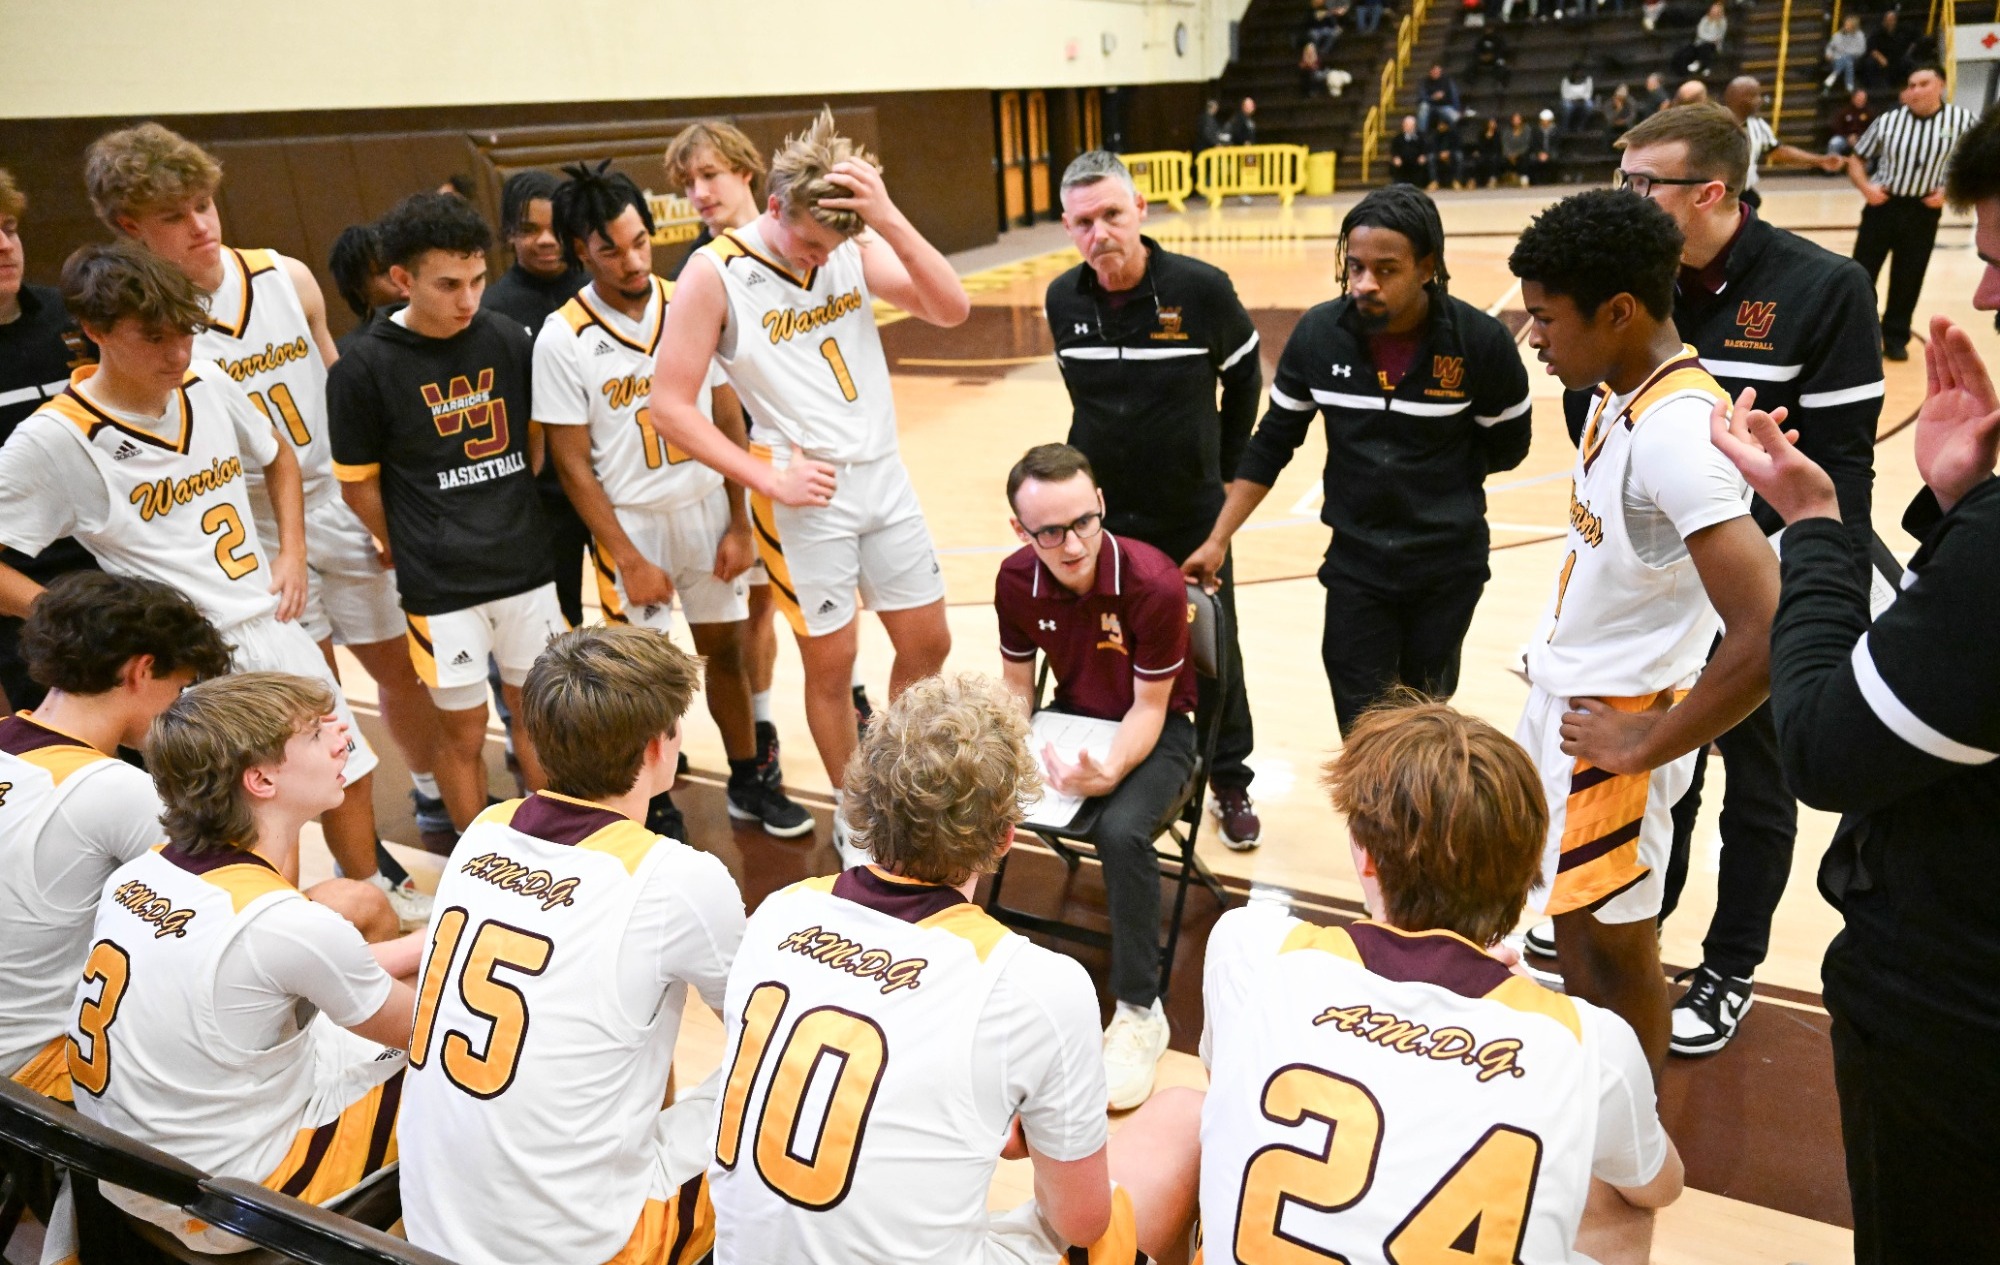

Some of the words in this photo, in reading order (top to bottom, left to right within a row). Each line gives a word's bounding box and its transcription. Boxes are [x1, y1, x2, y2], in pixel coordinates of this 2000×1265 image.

[762, 286, 862, 345] Warriors
[1724, 339, 1774, 351] BASKETBALL
[1735, 300, 1777, 339] WJ
[819, 337, 858, 403] 1
[431, 391, 490, 416] WARRIORS
[113, 448, 143, 461] adidas
[201, 502, 259, 580] 2
[112, 880, 197, 939] A.M.D.G.
[460, 852, 581, 912] A.M.D.G.
[777, 925, 928, 994] A.M.D.G.
[66, 938, 131, 1099] 3
[409, 905, 554, 1101] 15
[1311, 1004, 1526, 1083] A.M.D.G.
[715, 980, 889, 1213] 10
[1232, 1062, 1545, 1265] 24
